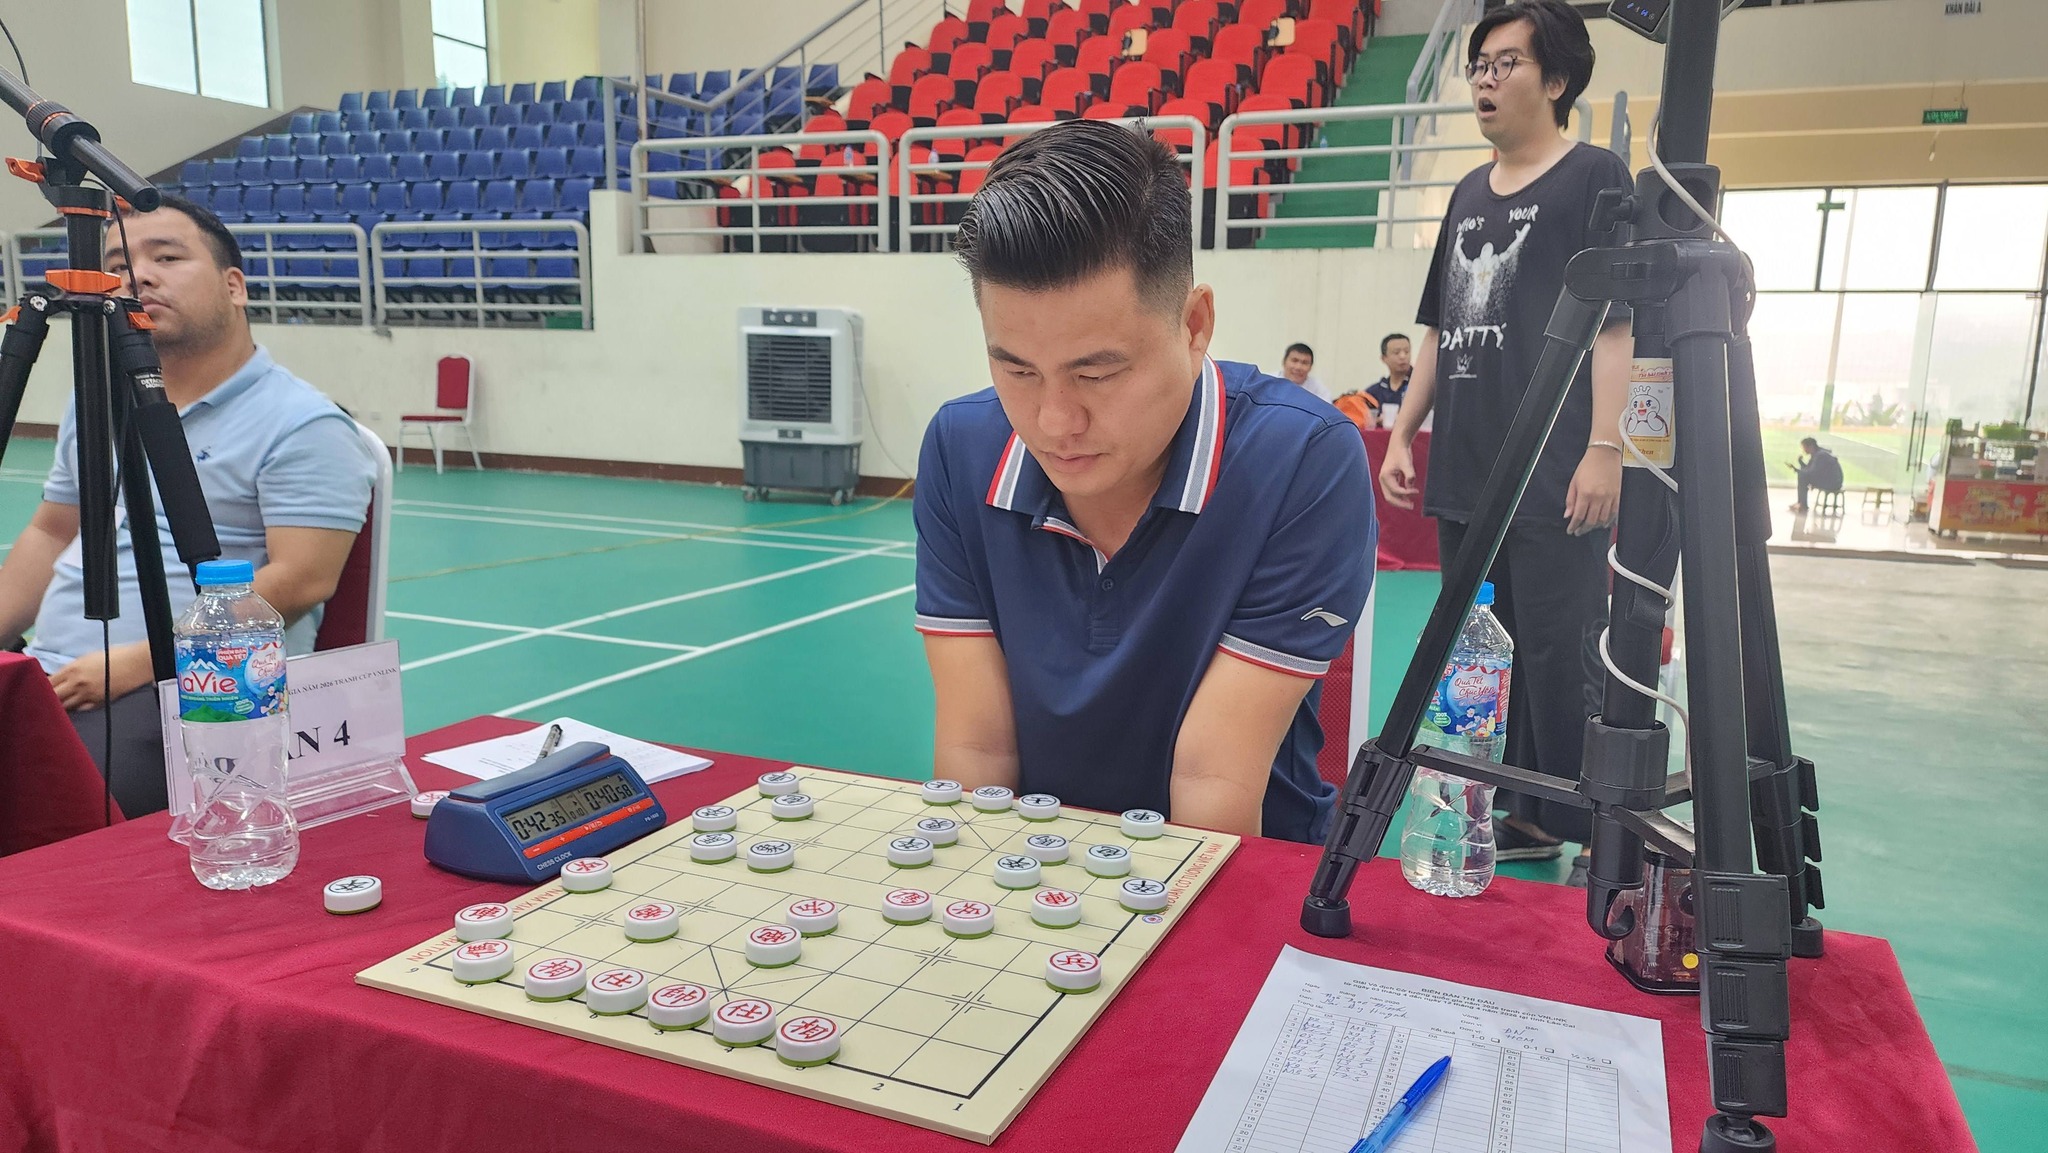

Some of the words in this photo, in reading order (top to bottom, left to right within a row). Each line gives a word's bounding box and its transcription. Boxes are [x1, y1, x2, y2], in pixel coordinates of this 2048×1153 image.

[1456, 215, 1485, 233] WHO'S
[1508, 204, 1539, 223] YOUR
[320, 681, 334, 689] 2026
[333, 720, 350, 746] 4
[1204, 842, 1223, 855] NAM
[536, 858, 555, 871] CHESS
[555, 851, 573, 863] CLOCK
[405, 935, 457, 962] RATION
[1537, 1013, 1567, 1023] VNLINK
[872, 1082, 885, 1092] 2
[953, 1102, 964, 1112] 1
